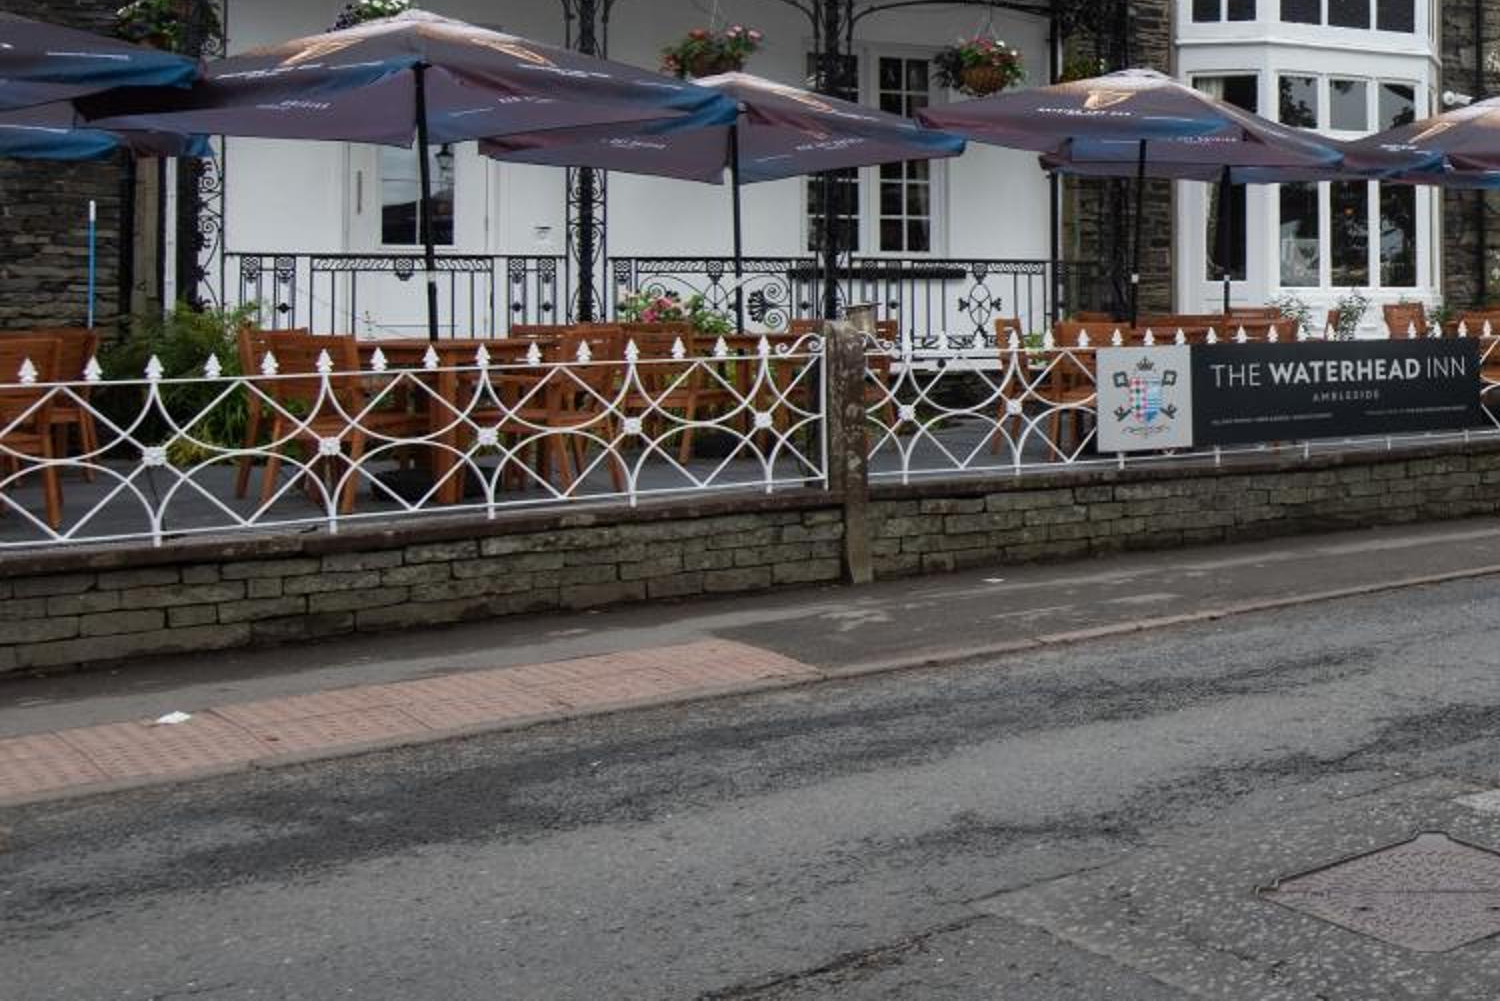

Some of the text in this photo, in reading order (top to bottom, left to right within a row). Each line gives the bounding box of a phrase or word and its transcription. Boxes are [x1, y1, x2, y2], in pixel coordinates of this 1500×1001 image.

[1210, 355, 1466, 388] THE WATERHEAD INN
[1312, 389, 1379, 402] AMBLESIDE
